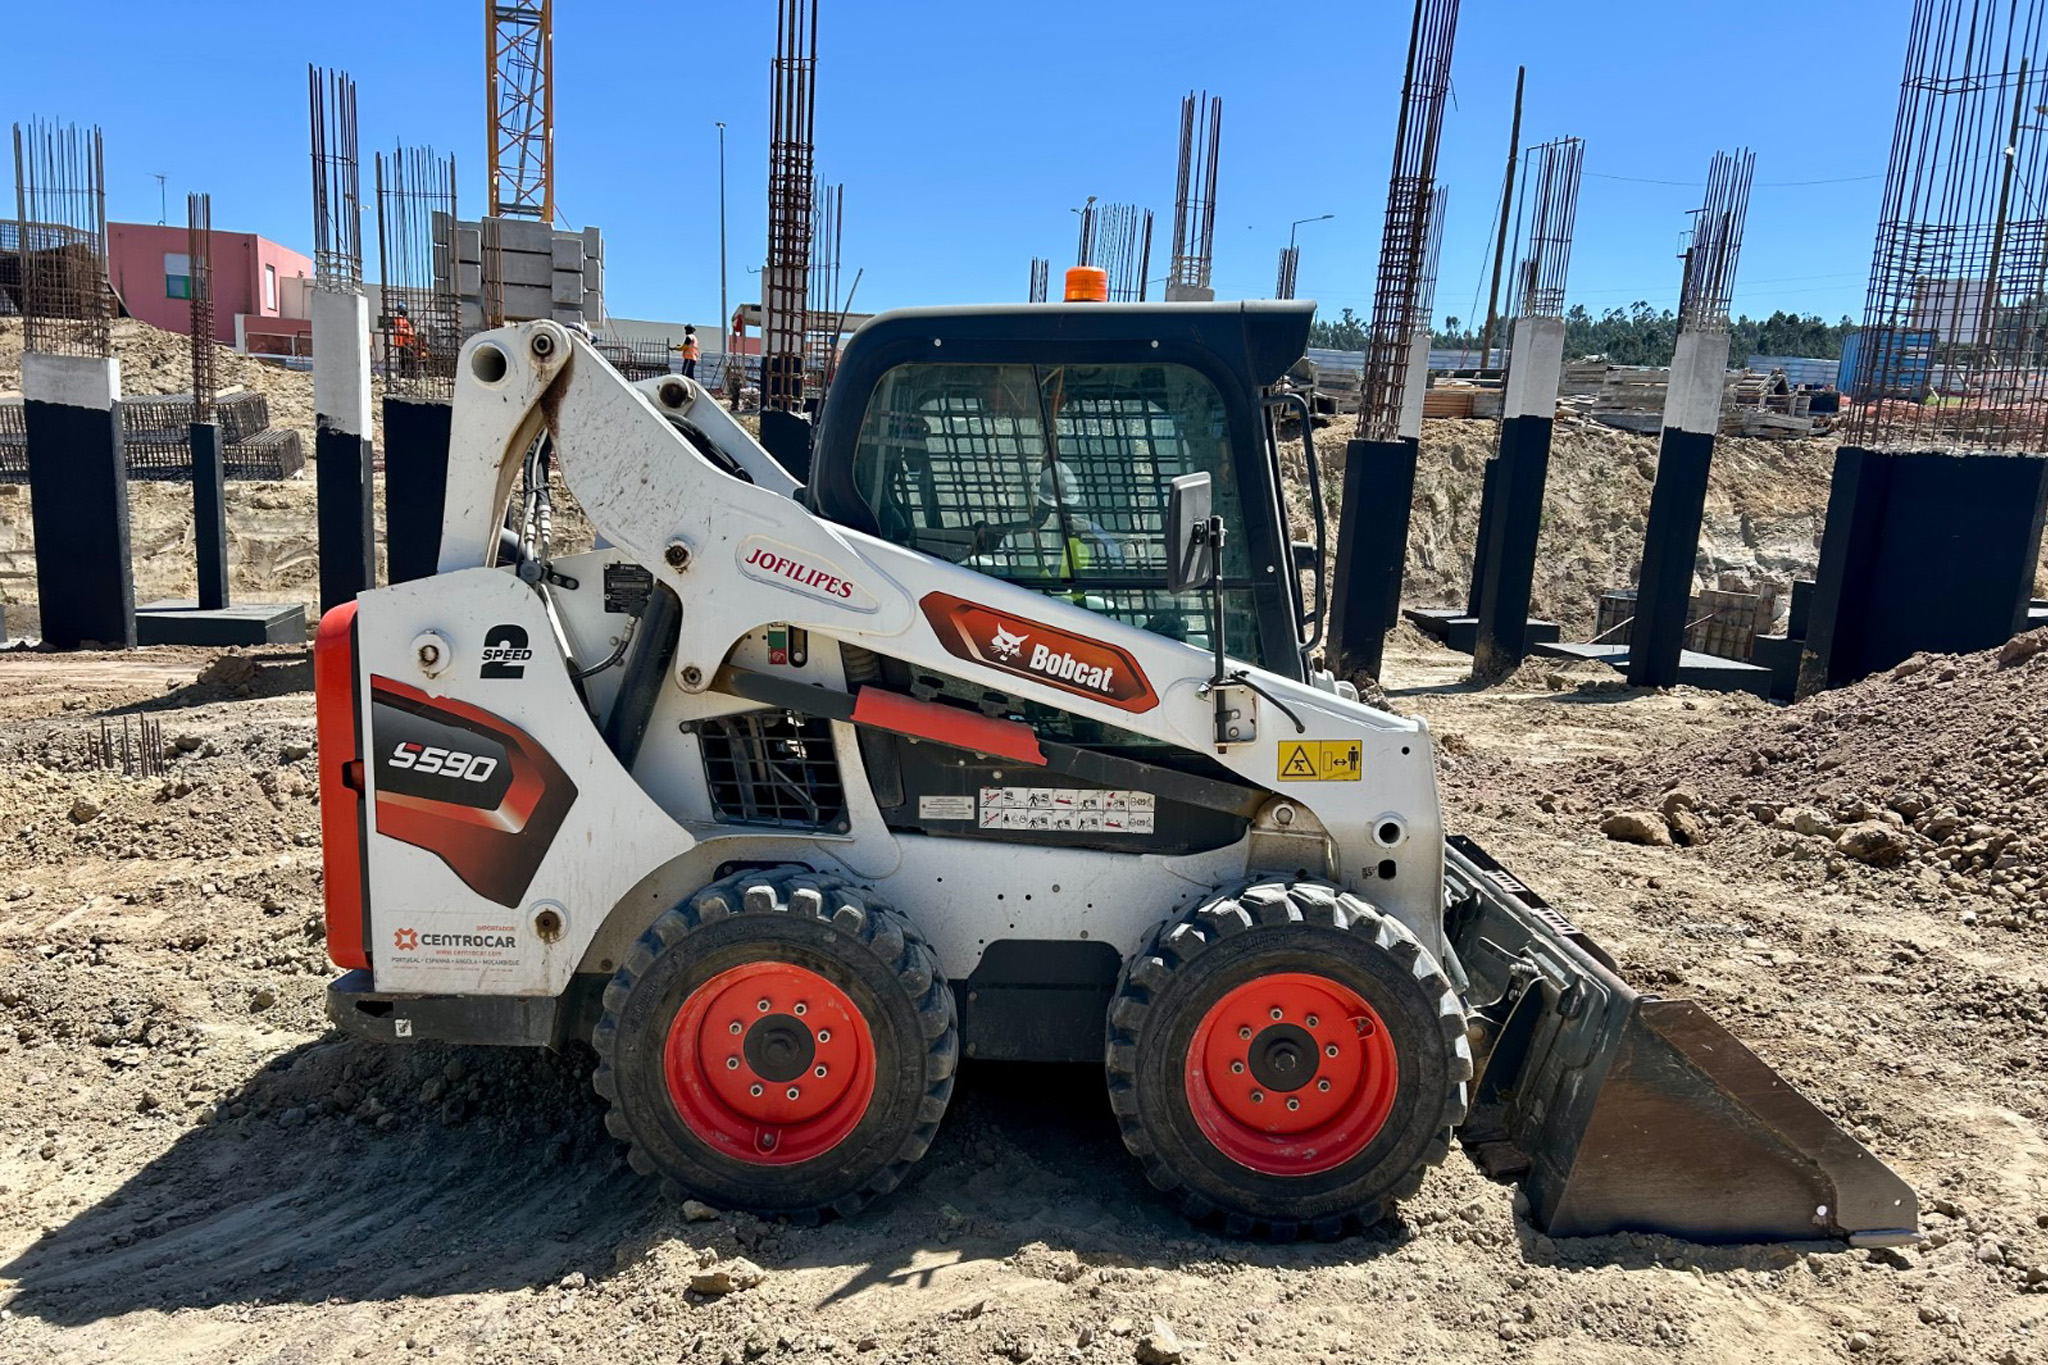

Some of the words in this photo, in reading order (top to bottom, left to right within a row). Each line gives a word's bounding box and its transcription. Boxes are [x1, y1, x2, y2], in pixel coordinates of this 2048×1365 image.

[745, 549, 854, 598] JOFILIPES
[480, 624, 529, 679] 2
[482, 649, 533, 660] SPEED
[1029, 643, 1113, 692] Bobcat
[388, 742, 498, 782] S590
